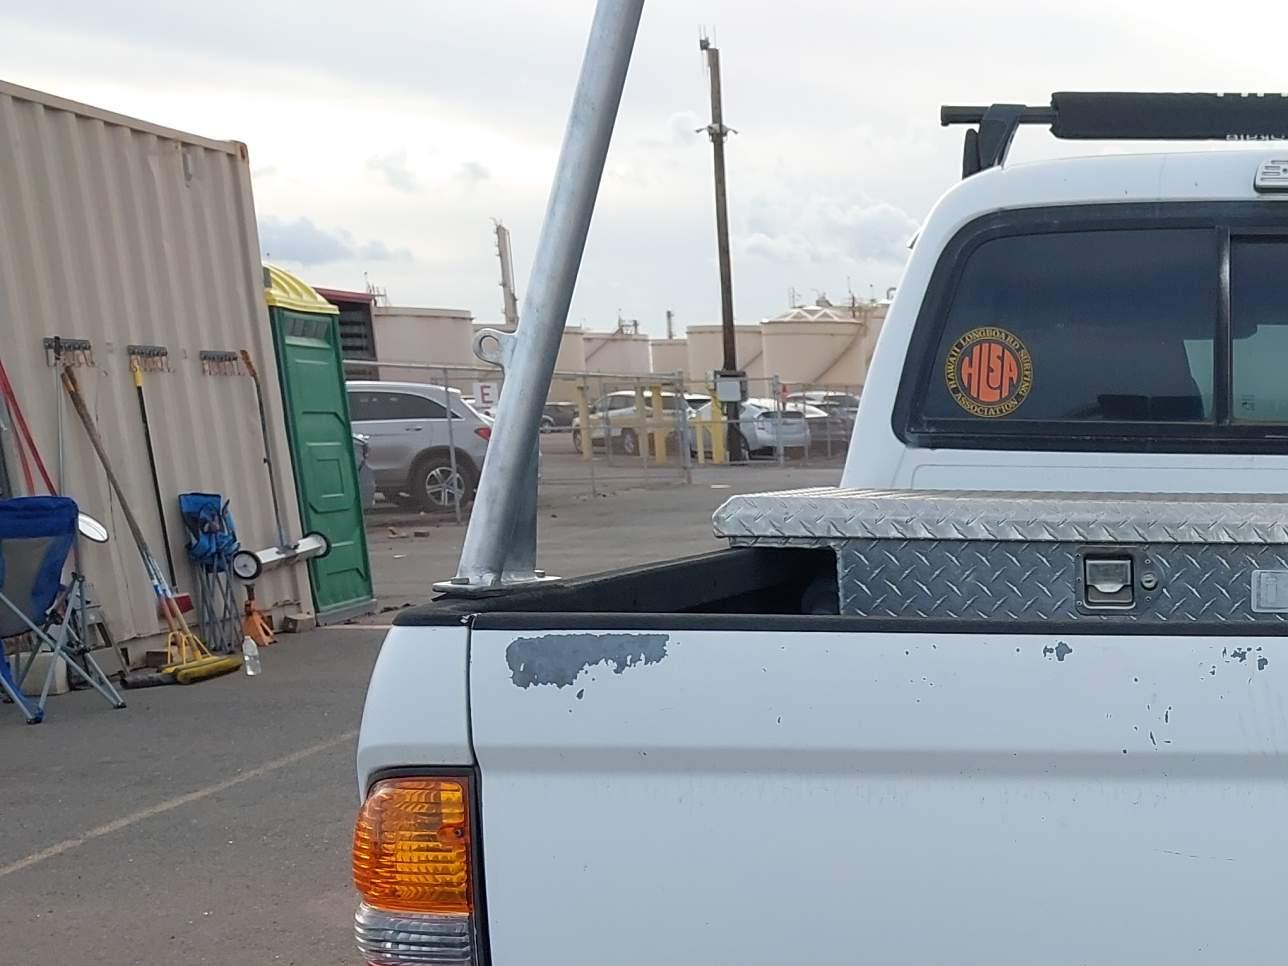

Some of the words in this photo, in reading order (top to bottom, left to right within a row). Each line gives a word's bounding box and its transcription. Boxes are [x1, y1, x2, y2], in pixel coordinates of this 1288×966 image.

[960, 329, 1021, 350] LONGBOARD
[961, 343, 1018, 402] HLSA
[956, 393, 1018, 415] ASSOCIATION
